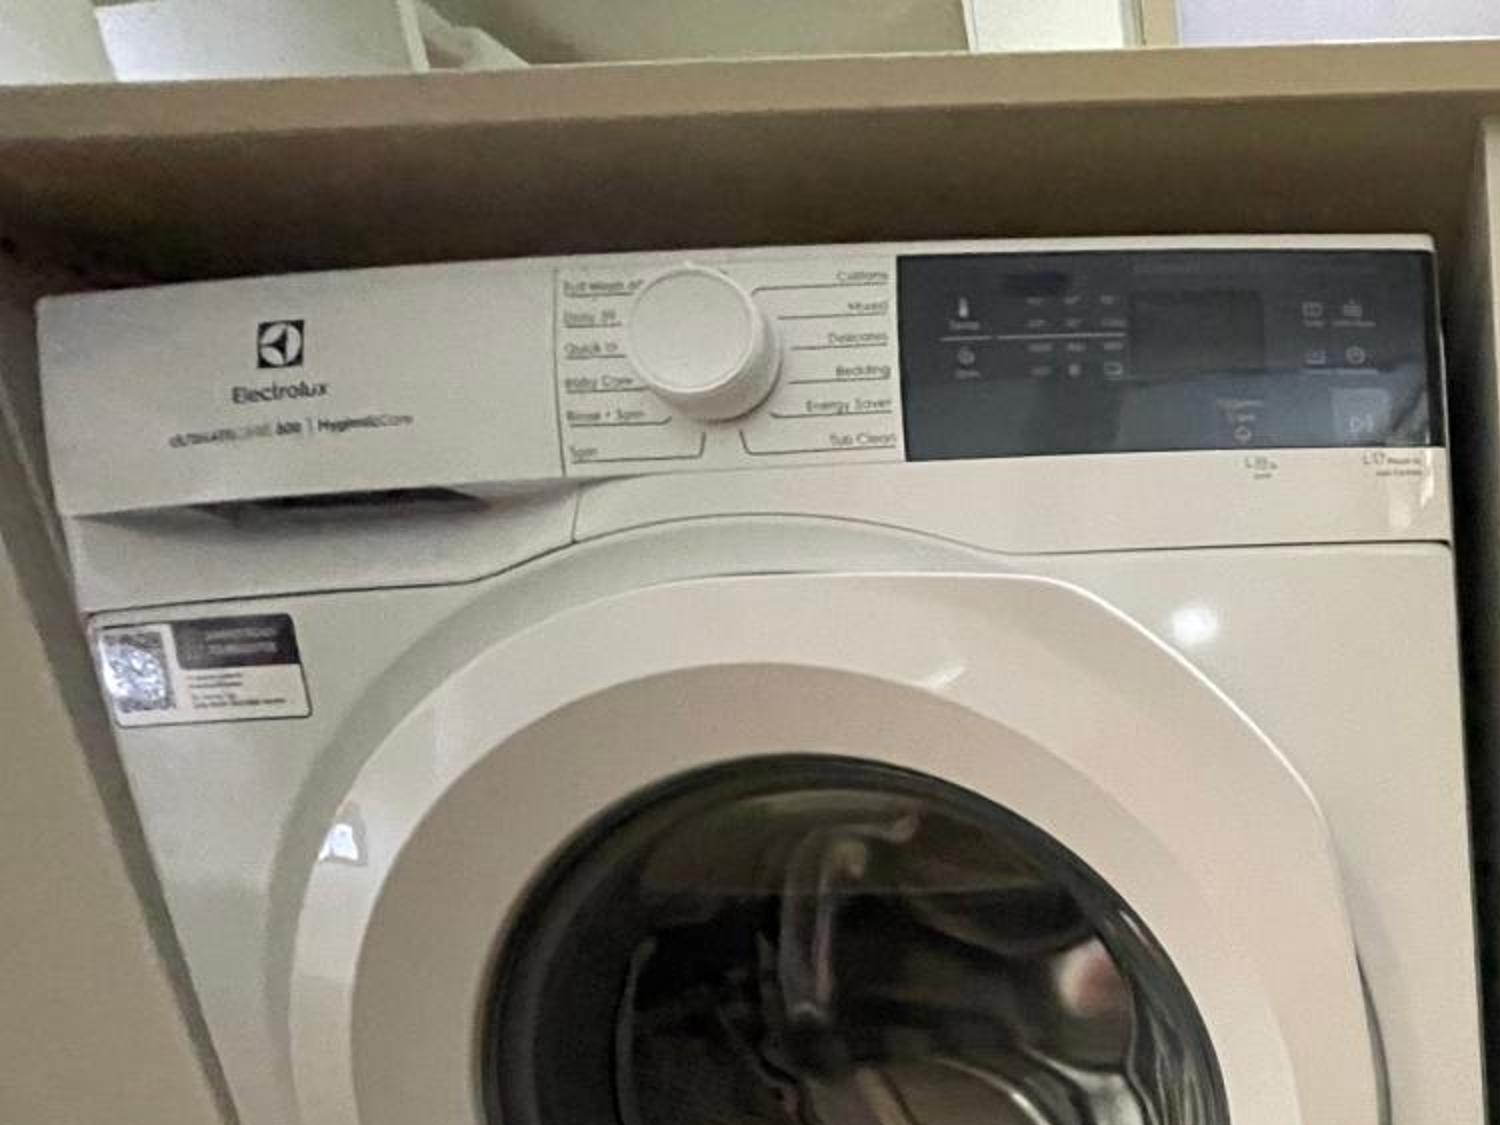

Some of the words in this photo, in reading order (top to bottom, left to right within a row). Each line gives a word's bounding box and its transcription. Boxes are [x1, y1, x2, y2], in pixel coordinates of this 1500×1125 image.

[563, 341, 601, 353] Quick
[835, 363, 892, 380] Bedding
[231, 380, 330, 405] Electrolux
[805, 399, 849, 416] Energy
[856, 432, 897, 446] Clean
